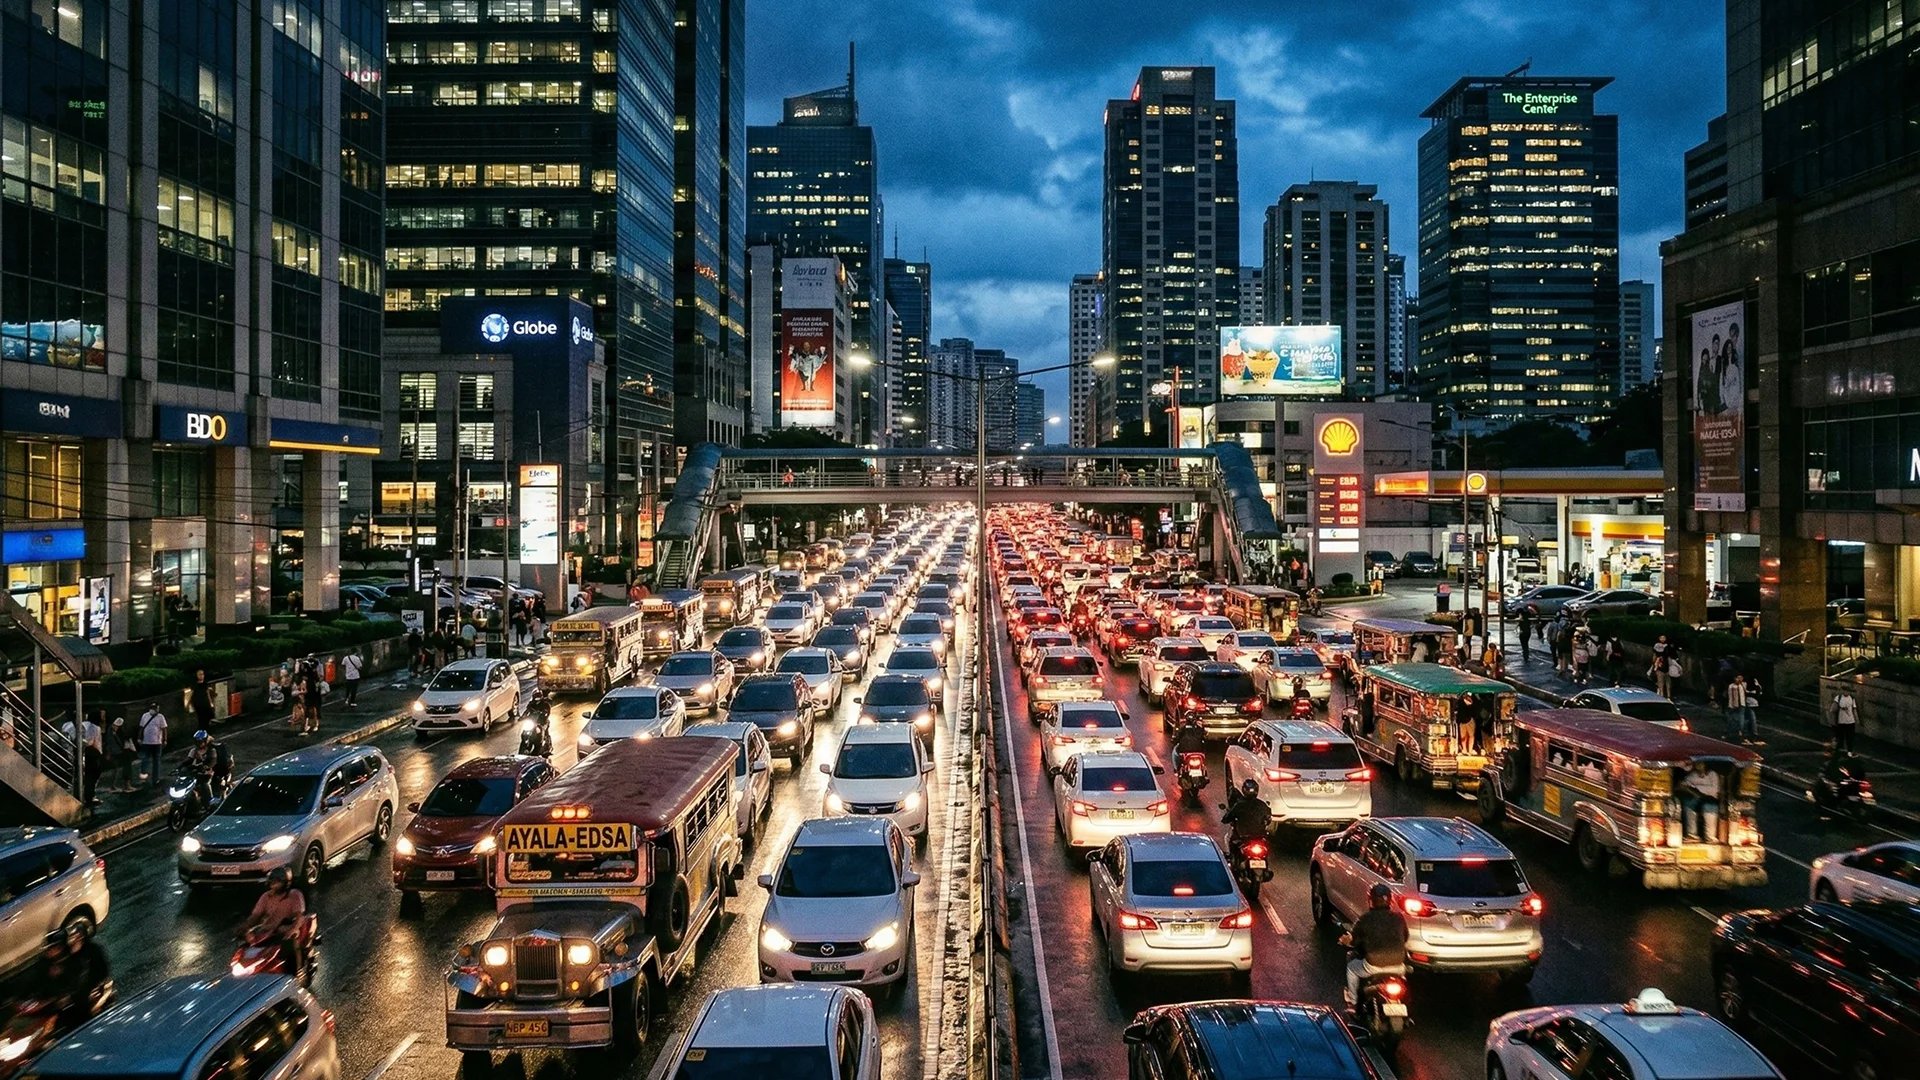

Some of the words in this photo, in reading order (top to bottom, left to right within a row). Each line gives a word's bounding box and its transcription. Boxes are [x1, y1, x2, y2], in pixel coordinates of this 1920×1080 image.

[1503, 93, 1522, 105] The
[1525, 92, 1577, 108] Enterprise
[1522, 106, 1558, 116] Center
[513, 320, 557, 335] Globe
[187, 413, 227, 440] BDO
[507, 827, 628, 849] AYALA-EDSA
